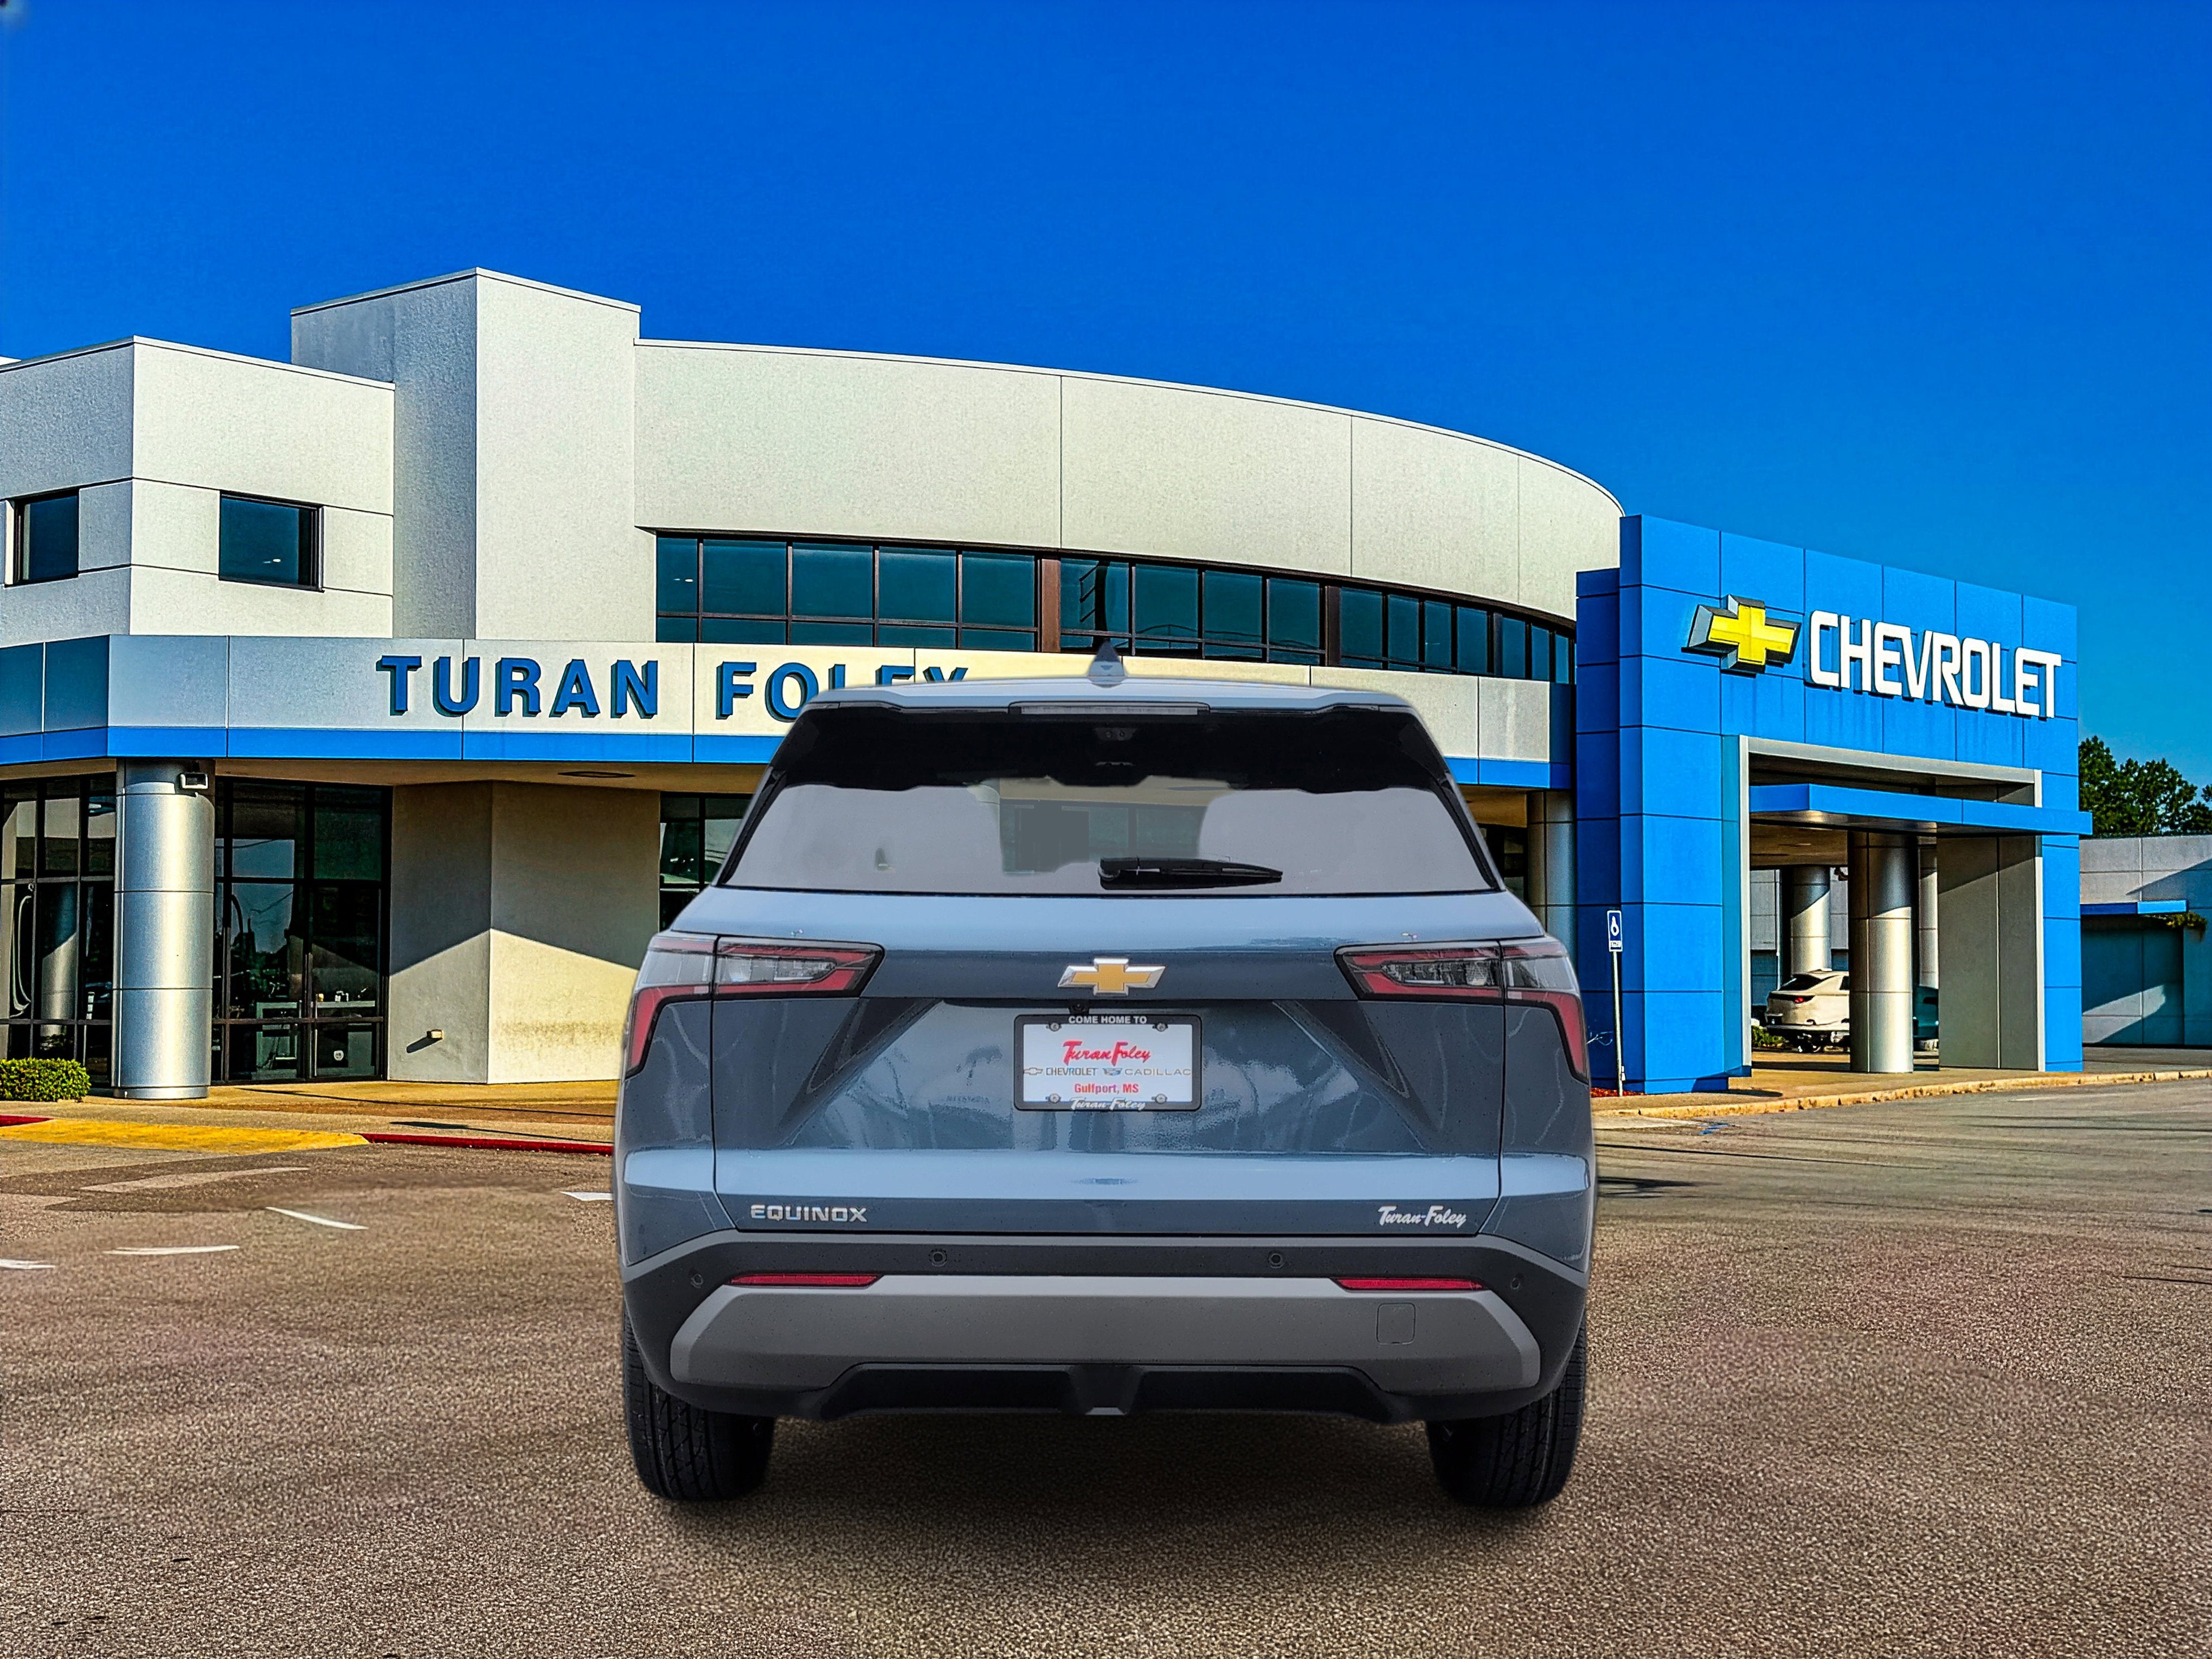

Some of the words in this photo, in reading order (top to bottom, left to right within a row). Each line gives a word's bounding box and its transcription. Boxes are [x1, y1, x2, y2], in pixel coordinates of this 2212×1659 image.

[1809, 609, 2062, 719] CHEVROLET
[376, 655, 659, 719] TURAN
[1069, 1015, 1098, 1024] COME
[1101, 1015, 1131, 1024] HOME
[1133, 1015, 1147, 1024] TO
[1063, 1040, 1111, 1066] Turan
[1110, 1041, 1151, 1066] Foley
[1045, 1067, 1097, 1076] CHEVROLET
[1075, 1083, 1120, 1094] Gulfport,
[1122, 1084, 1139, 1093] MS
[750, 1204, 867, 1223] EQUINOX
[1378, 1205, 1422, 1227] Turan
[1423, 1205, 1467, 1229] Foley
